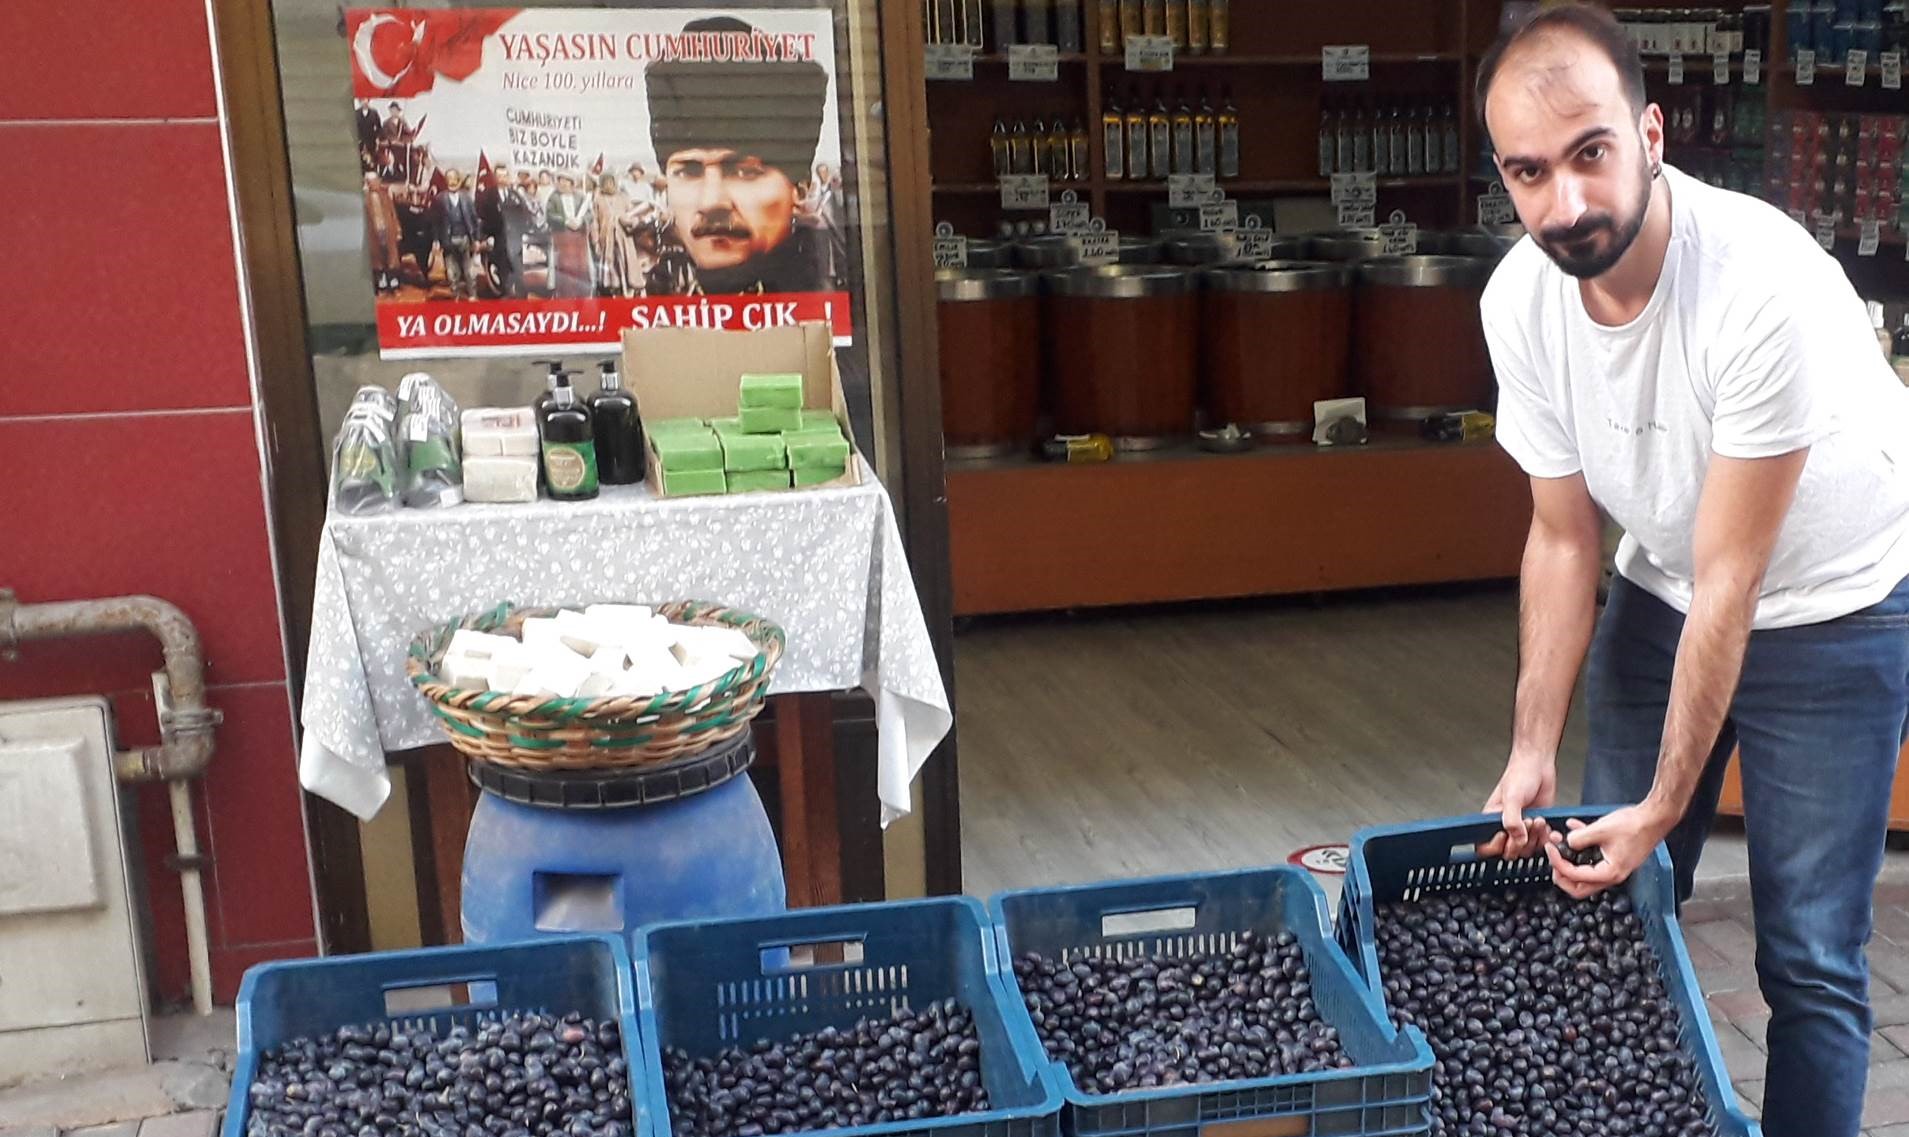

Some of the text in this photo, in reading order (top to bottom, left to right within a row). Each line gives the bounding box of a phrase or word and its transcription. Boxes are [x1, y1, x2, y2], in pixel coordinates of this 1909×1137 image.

[499, 28, 816, 67] YAŞASIN CUMHURİYET
[503, 71, 538, 89] Nice
[544, 71, 577, 89] 100.
[512, 149, 580, 169] KAZANDIK
[396, 314, 426, 338] YA
[433, 311, 606, 336] OLMASAYDI...!
[631, 297, 734, 331] SAHİP
